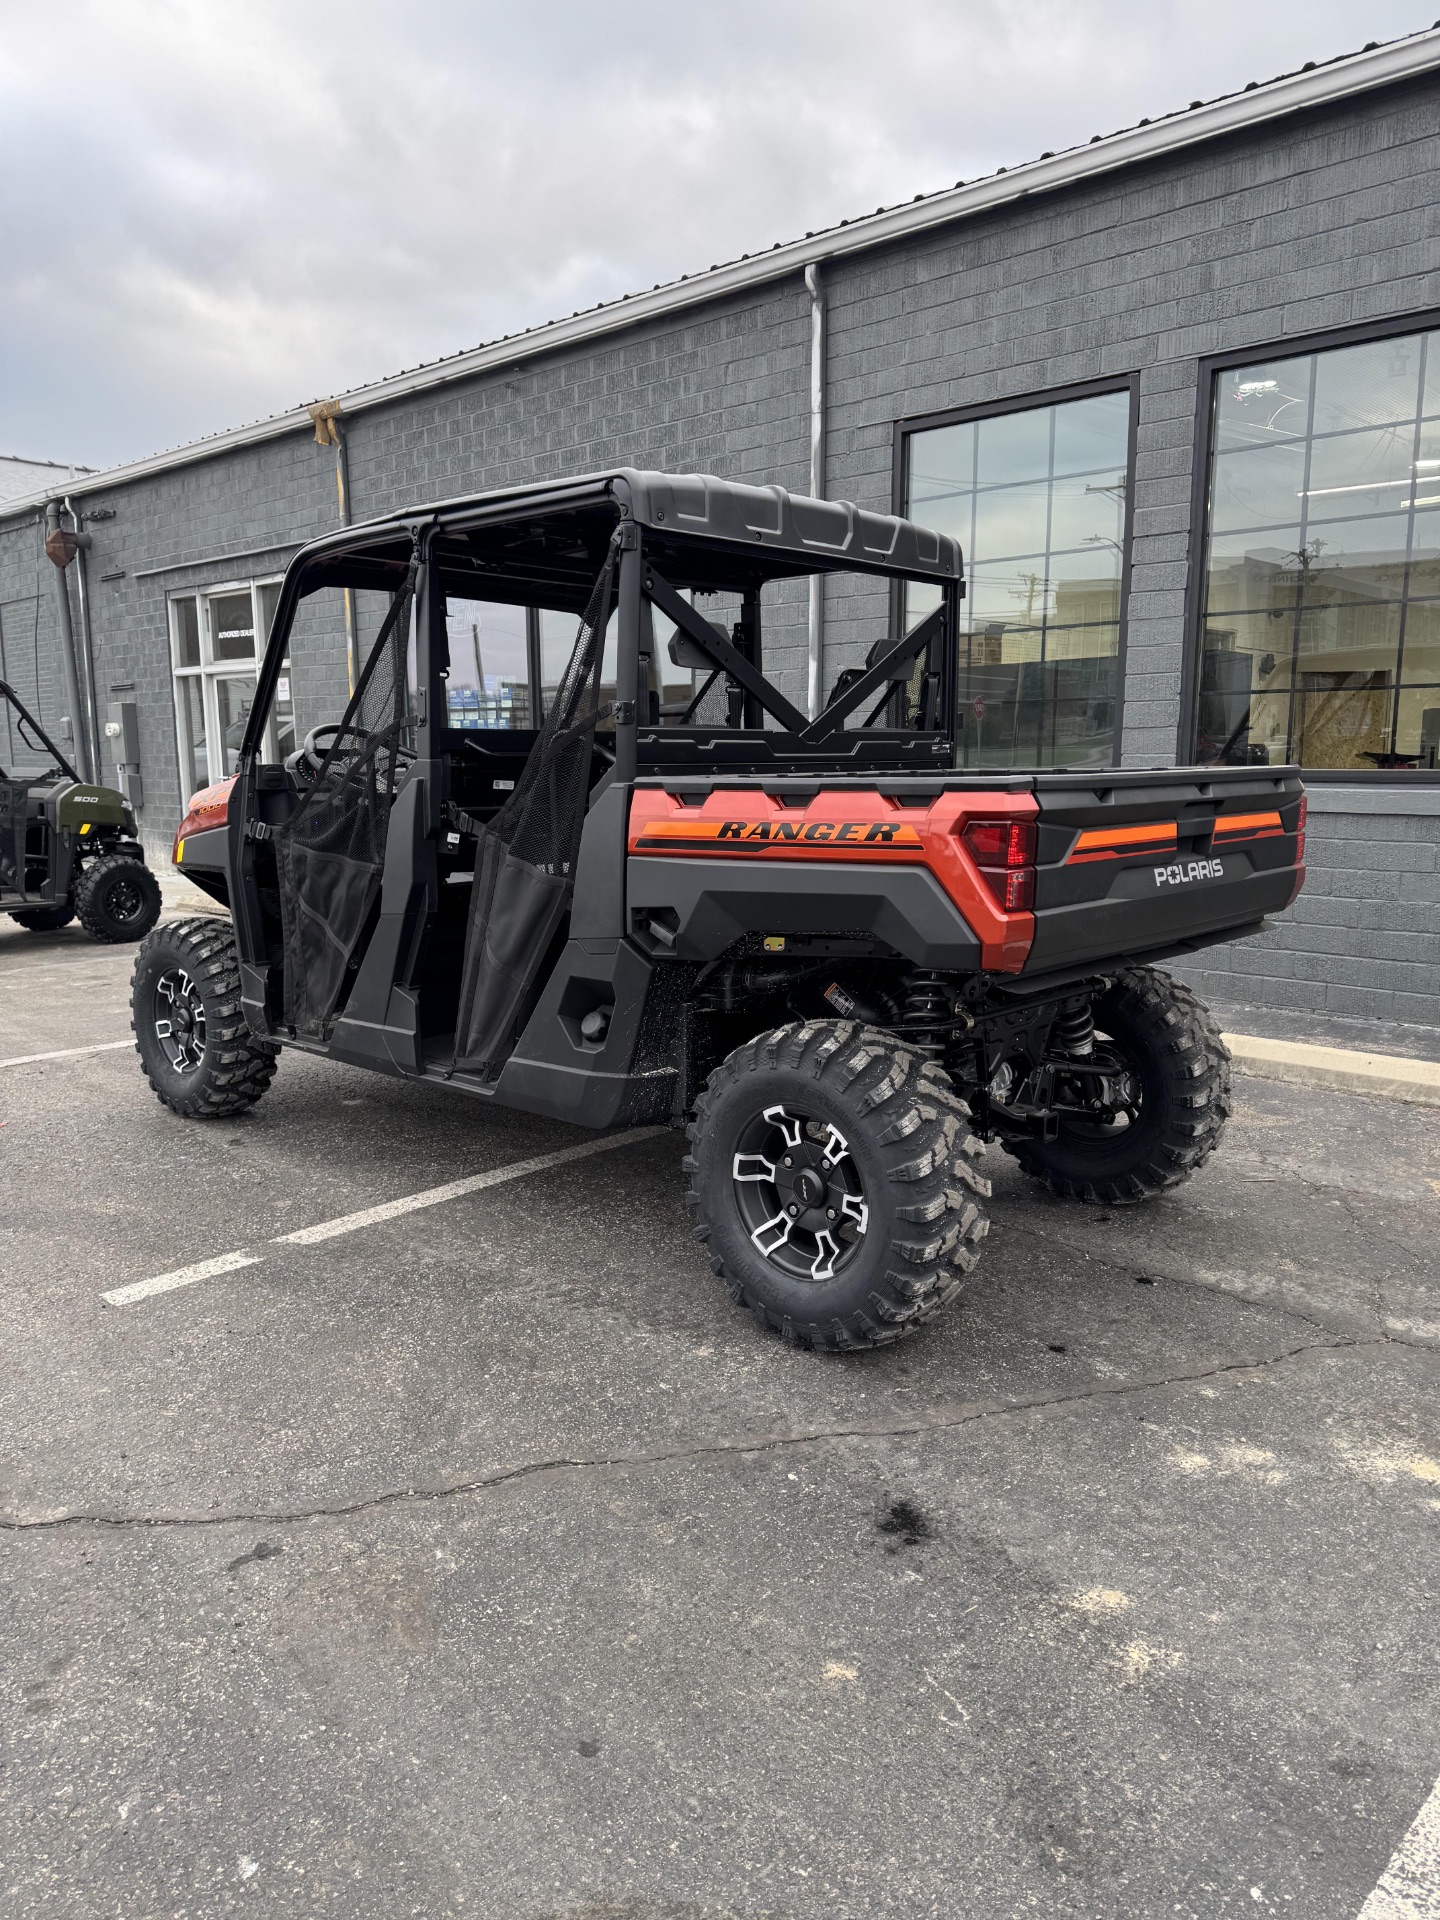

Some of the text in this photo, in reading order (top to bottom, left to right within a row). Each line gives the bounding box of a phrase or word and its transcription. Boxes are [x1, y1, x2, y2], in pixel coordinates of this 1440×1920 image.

[447, 602, 477, 631] PEN
[73, 795, 99, 803] 500
[199, 802, 222, 815] 1000
[716, 821, 902, 842] RANGER
[1153, 858, 1224, 887] POLARIS
